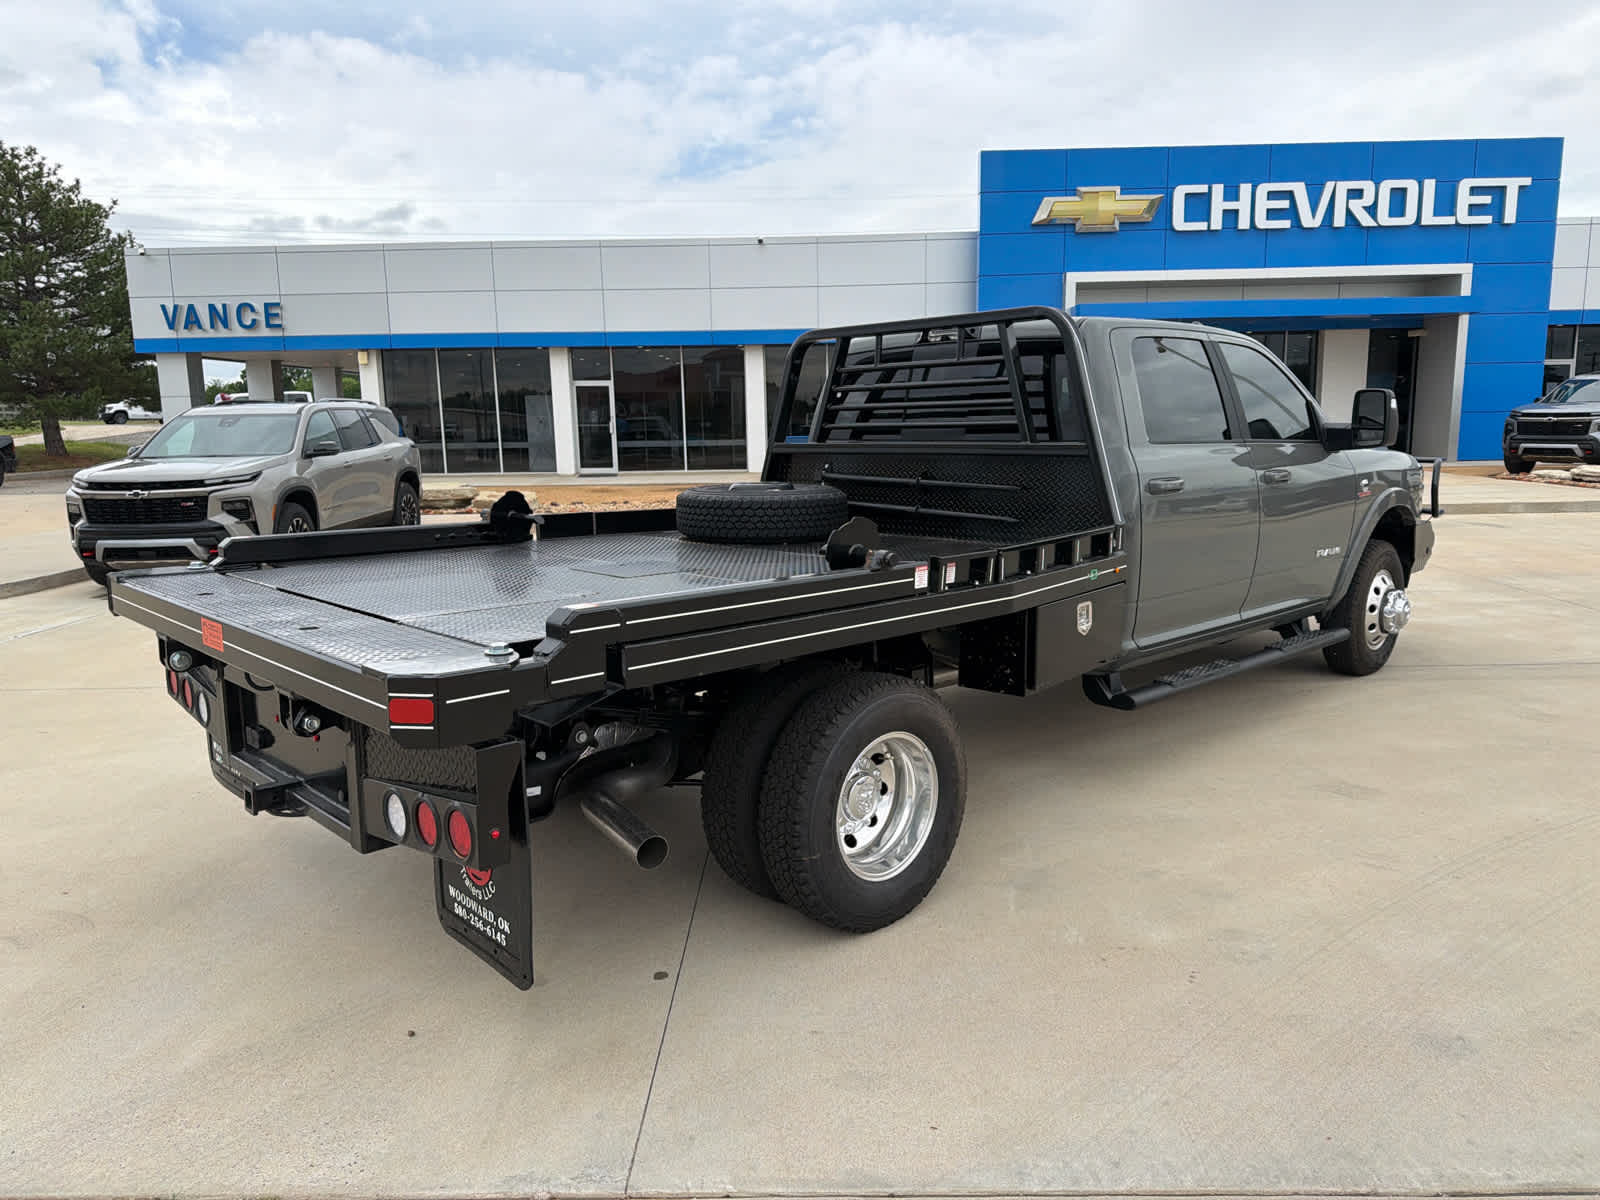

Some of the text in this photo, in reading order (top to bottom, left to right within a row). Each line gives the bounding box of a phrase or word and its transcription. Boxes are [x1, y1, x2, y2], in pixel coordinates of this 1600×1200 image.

[1172, 176, 1533, 232] CHEVROLET
[160, 302, 283, 331] VANCE
[482, 880, 496, 900] LLC
[498, 916, 511, 934] OK
